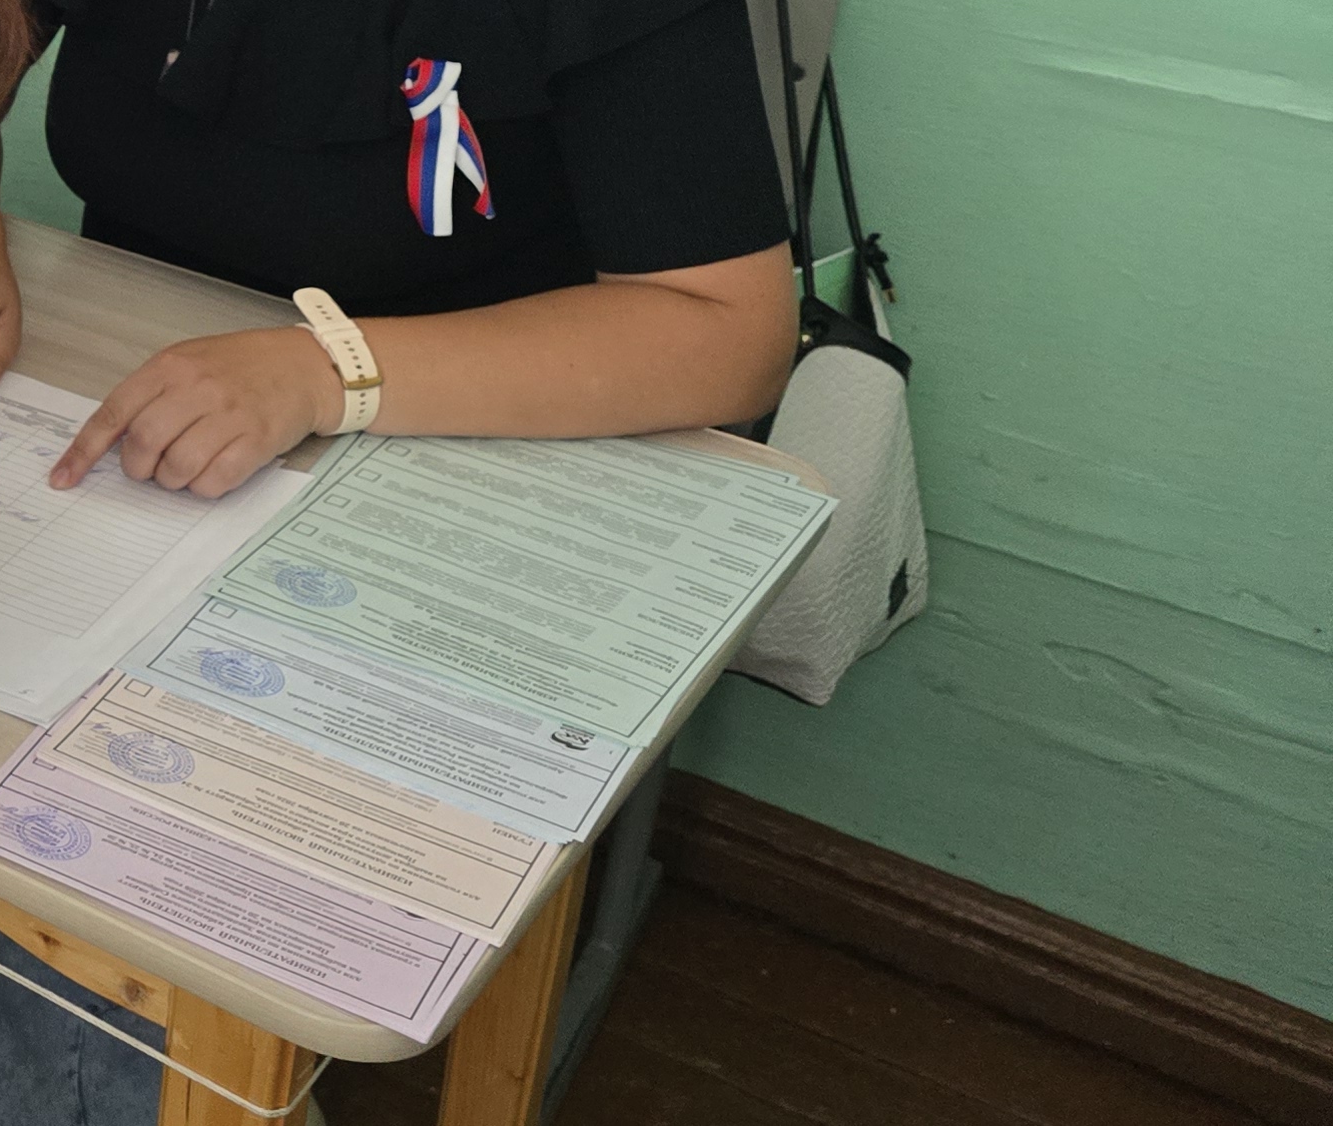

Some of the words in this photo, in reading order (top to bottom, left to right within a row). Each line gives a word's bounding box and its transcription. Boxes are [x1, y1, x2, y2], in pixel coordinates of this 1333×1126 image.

[321, 724, 397, 757] БЮЛЛЕТЕНЬ
[398, 753, 503, 798] ИЗБИРАТЕЛЬНЫЙ
[229, 809, 305, 843] БЮЛЛЕТЕНЬ
[307, 840, 413, 887] ИЗБИРАТЕЛЬНЫЙ
[137, 895, 215, 932] БЮЛЛЕТЕНЬ
[218, 929, 327, 979] ИЗБИРАТЕЛЬНЫЙ
